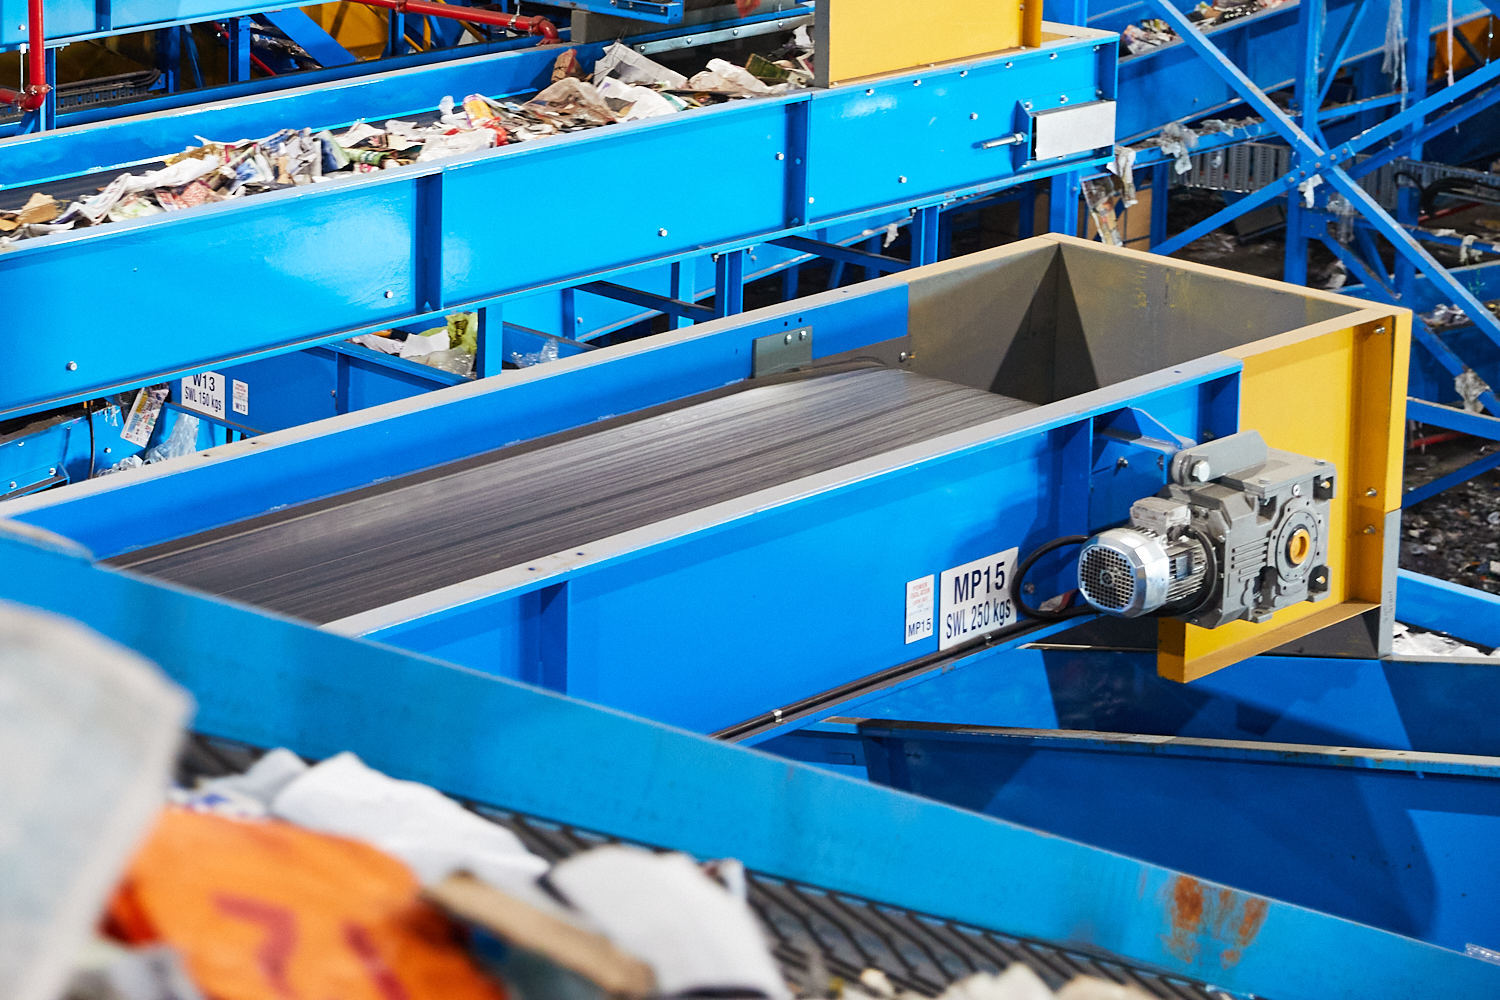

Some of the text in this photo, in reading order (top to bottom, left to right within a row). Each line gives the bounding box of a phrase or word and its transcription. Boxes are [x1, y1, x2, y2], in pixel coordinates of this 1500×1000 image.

[193, 373, 215, 391] W13
[185, 386, 222, 412] SWL 150 kgs
[954, 561, 1005, 604] MP15
[908, 617, 931, 637] MP15
[946, 597, 1011, 639] SWL 250 kgs
